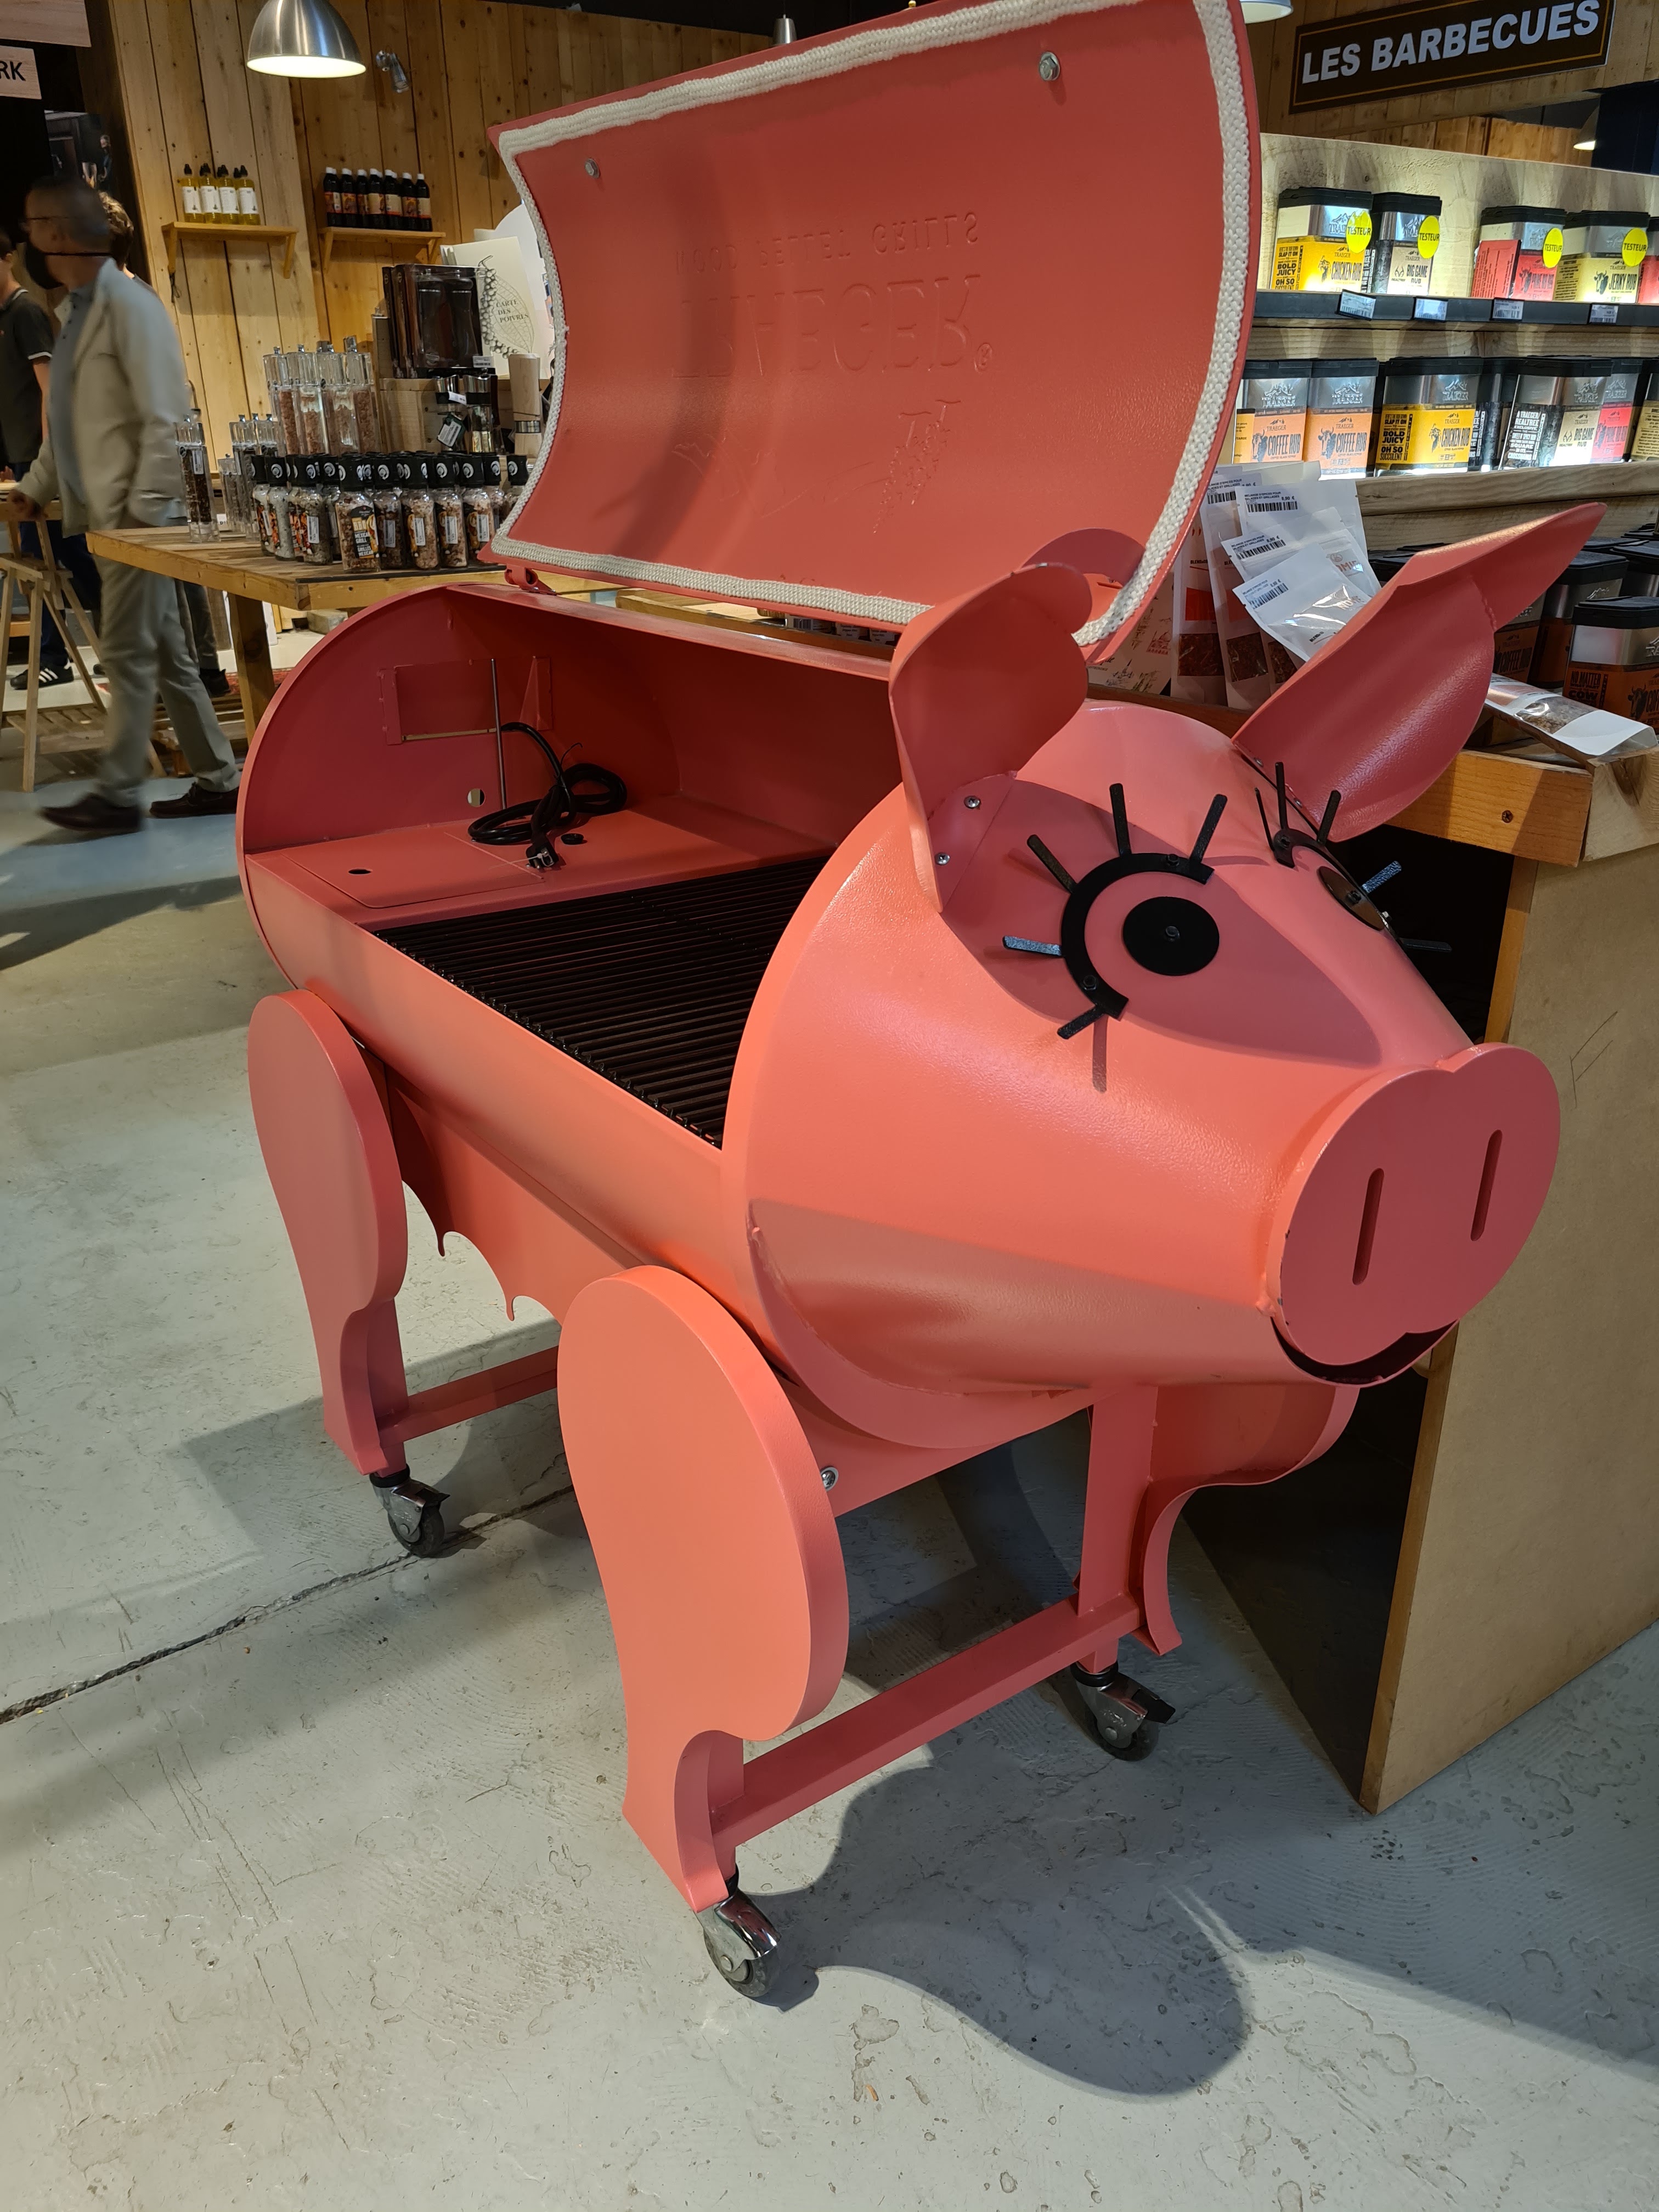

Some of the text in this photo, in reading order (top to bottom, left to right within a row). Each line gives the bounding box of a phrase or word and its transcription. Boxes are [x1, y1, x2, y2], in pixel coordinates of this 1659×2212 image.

[1302, 0, 1600, 84] LES BARBECUES
[1347, 225, 1371, 236] TESTEUR
[1419, 233, 1440, 241] TESTEUR
[1544, 243, 1562, 253] TESTEUR
[1623, 242, 1647, 252] TESTEUR
[1331, 261, 1353, 280] CHICKEN
[1352, 262, 1362, 281] RUB
[1406, 264, 1428, 277] BIG GAME
[1609, 273, 1638, 290] JERKY RUB
[496, 299, 518, 308] CARTE
[499, 313, 529, 323] POIVRES
[1515, 418, 1539, 427] REALTREE
[1336, 432, 1368, 453] COFFEE RUB
[1441, 427, 1462, 447] CHICKEN
[1460, 427, 1471, 447] RUB
[1268, 435, 1289, 456] COFFEE
[1289, 433, 1301, 454] RUB
[1570, 670, 1601, 687] NO MATTER
[1568, 690, 1599, 700] COW
